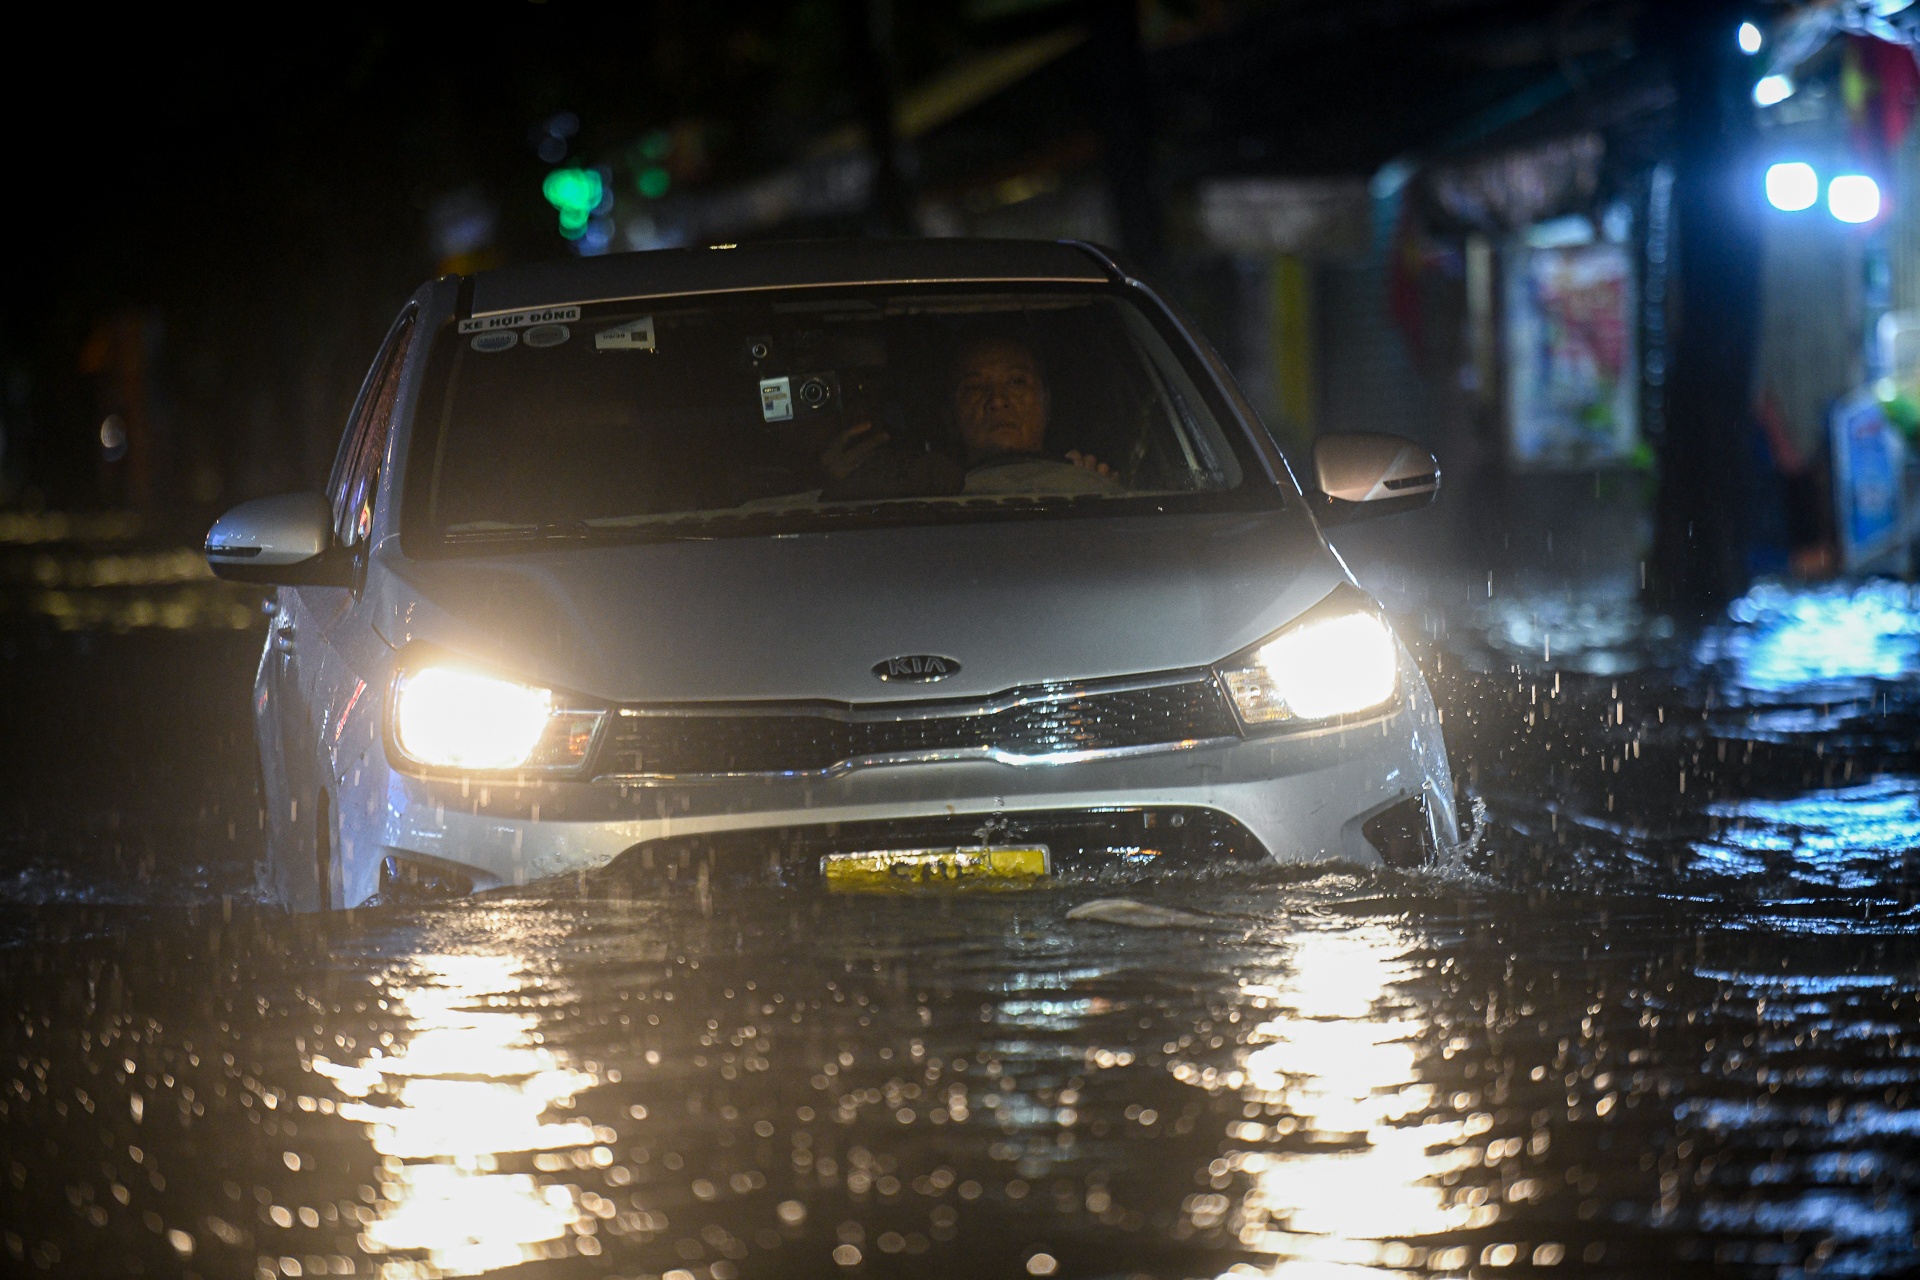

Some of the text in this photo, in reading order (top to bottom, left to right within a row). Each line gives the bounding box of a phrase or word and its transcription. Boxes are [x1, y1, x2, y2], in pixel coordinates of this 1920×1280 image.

[463, 320, 483, 331] XE
[489, 315, 524, 327] HỢP
[887, 657, 947, 676] KIA
